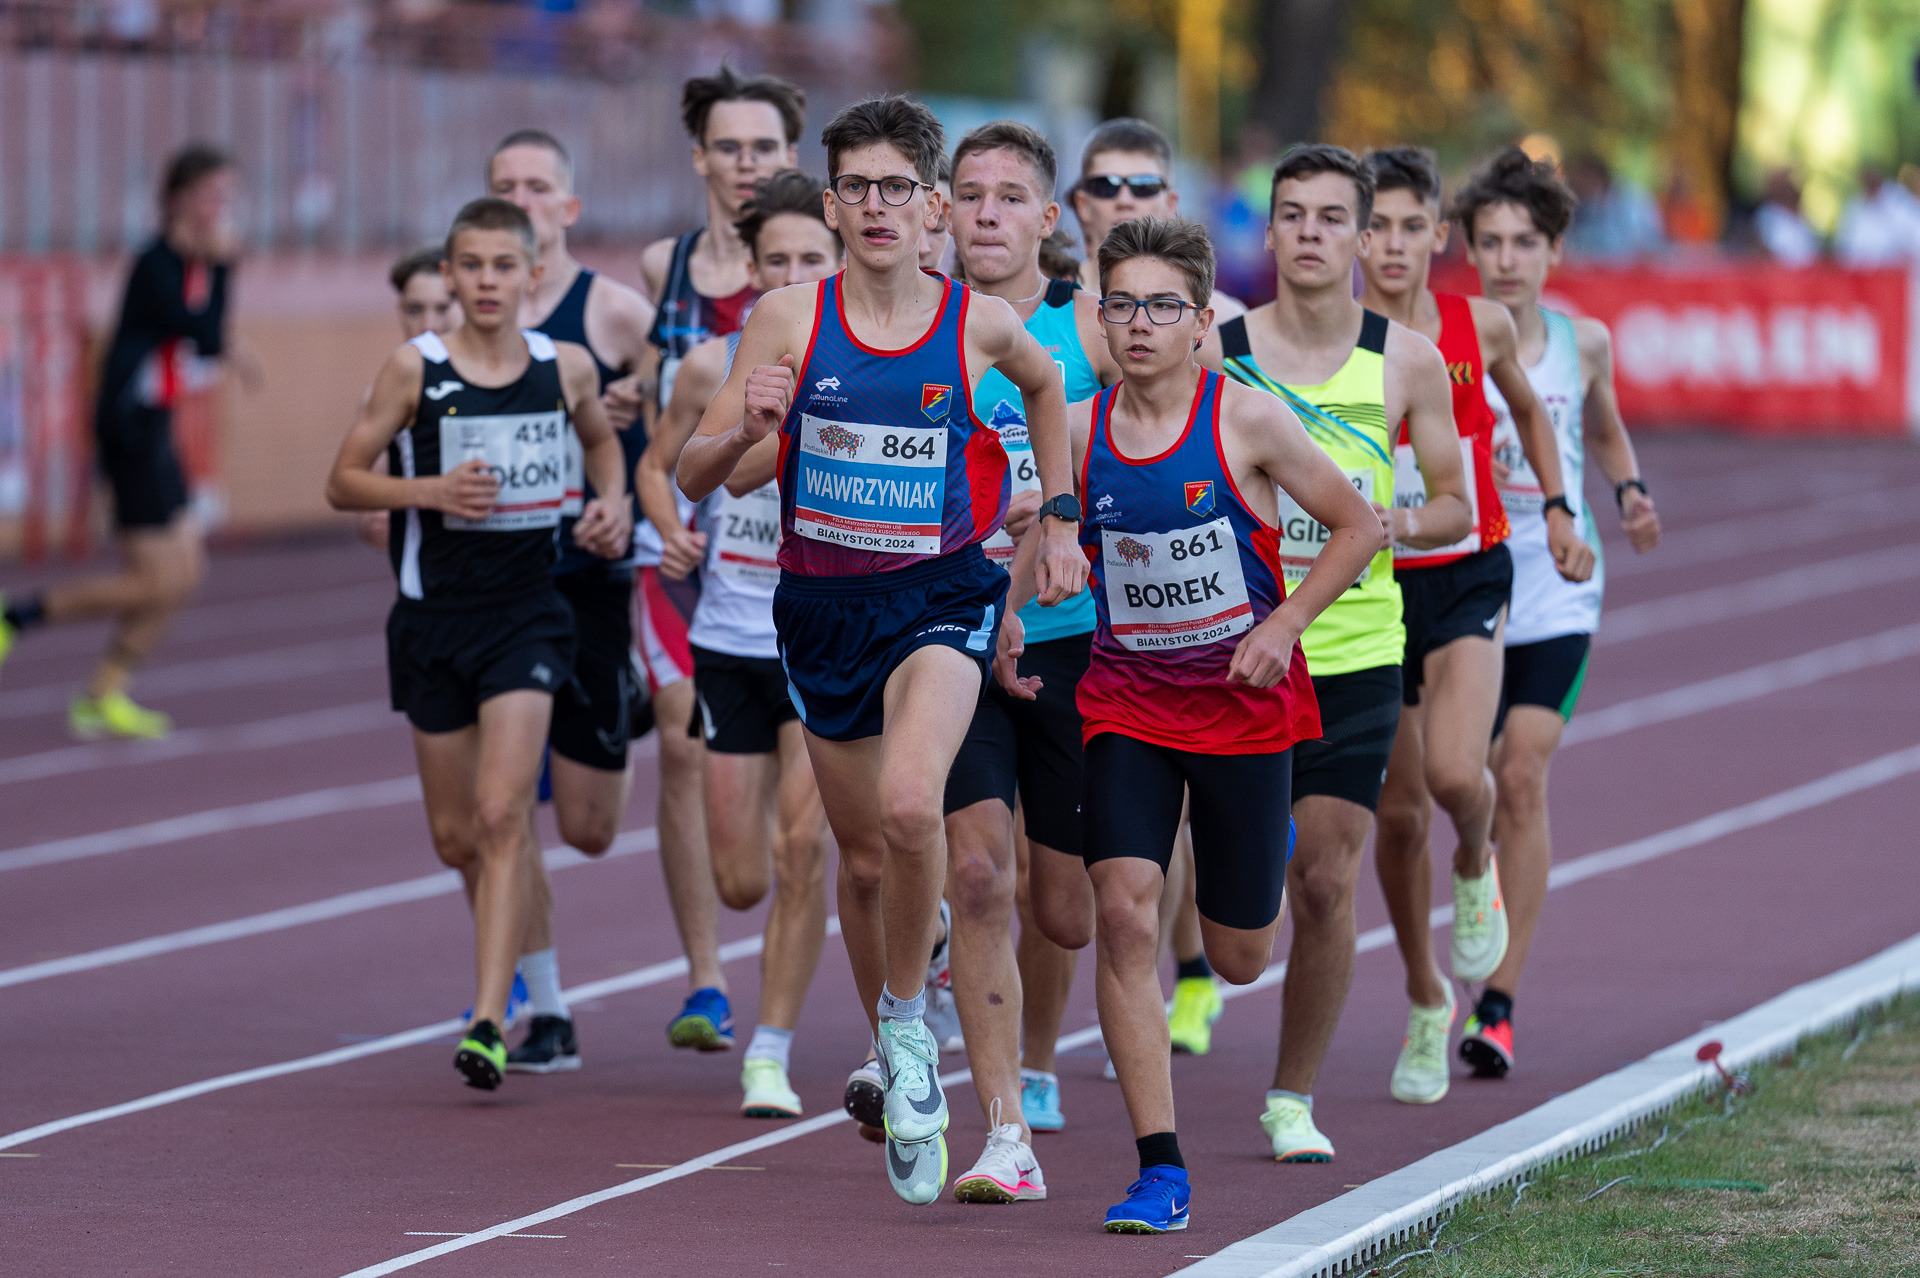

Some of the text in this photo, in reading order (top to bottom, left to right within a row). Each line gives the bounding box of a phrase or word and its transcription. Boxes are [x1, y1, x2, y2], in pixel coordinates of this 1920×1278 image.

[514, 421, 557, 444] 414
[803, 442, 829, 455] Podlaskie
[881, 434, 935, 460] 864
[474, 454, 560, 490] OŁOŃ
[1016, 458, 1040, 481] 6
[805, 466, 938, 509] WAWRZYNIAK
[844, 519, 876, 528] Mistrzostwa
[853, 526, 877, 534] JANUSZA
[817, 527, 915, 549] BIAŁYSTOK 2024
[1169, 529, 1223, 561] 861
[1106, 559, 1128, 568] Podlaskie
[1124, 571, 1226, 609] BOREK
[1136, 624, 1232, 647] BIAŁYSTOK 2024
